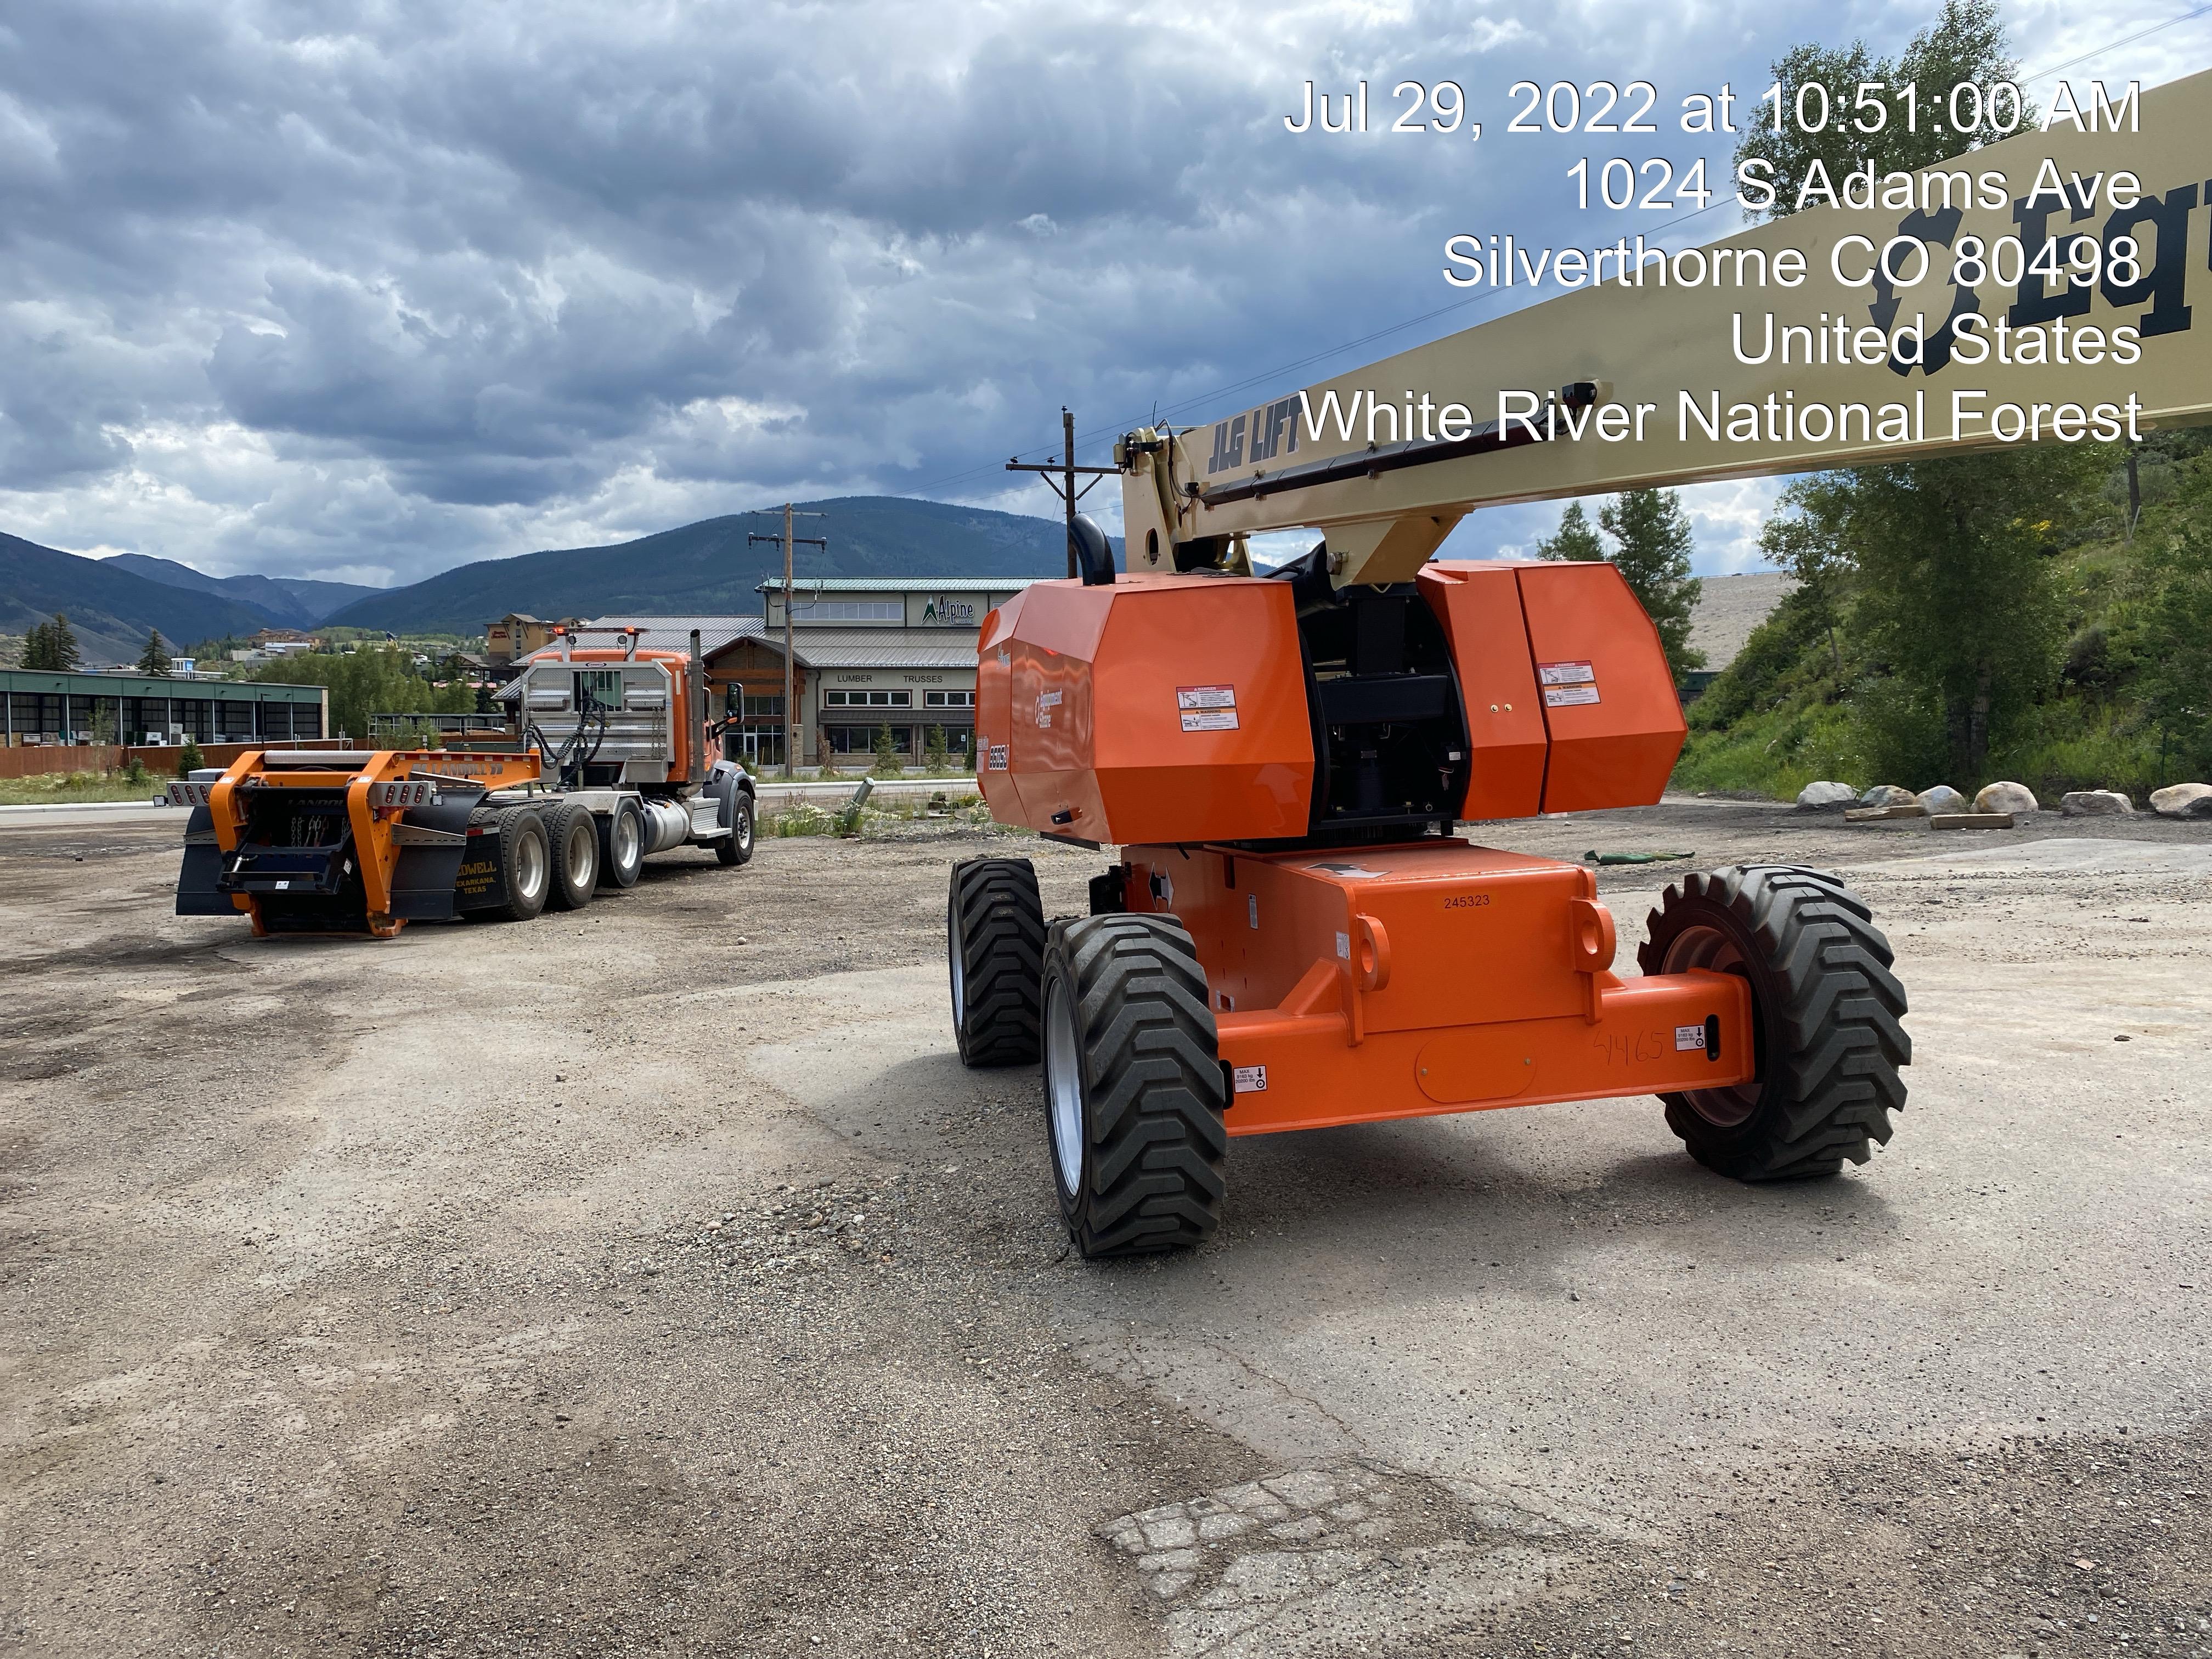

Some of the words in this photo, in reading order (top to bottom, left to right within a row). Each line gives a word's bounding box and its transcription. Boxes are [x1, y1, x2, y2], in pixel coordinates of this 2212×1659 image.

[2008, 174, 2212, 338] Eq
[1207, 413, 1247, 475] JLG
[1249, 393, 1304, 464] LIFT
[938, 594, 974, 625] Alpine
[456, 877, 496, 887] EXARKANA,
[464, 885, 487, 894] TEXAS
[1444, 894, 1490, 909] 245323
